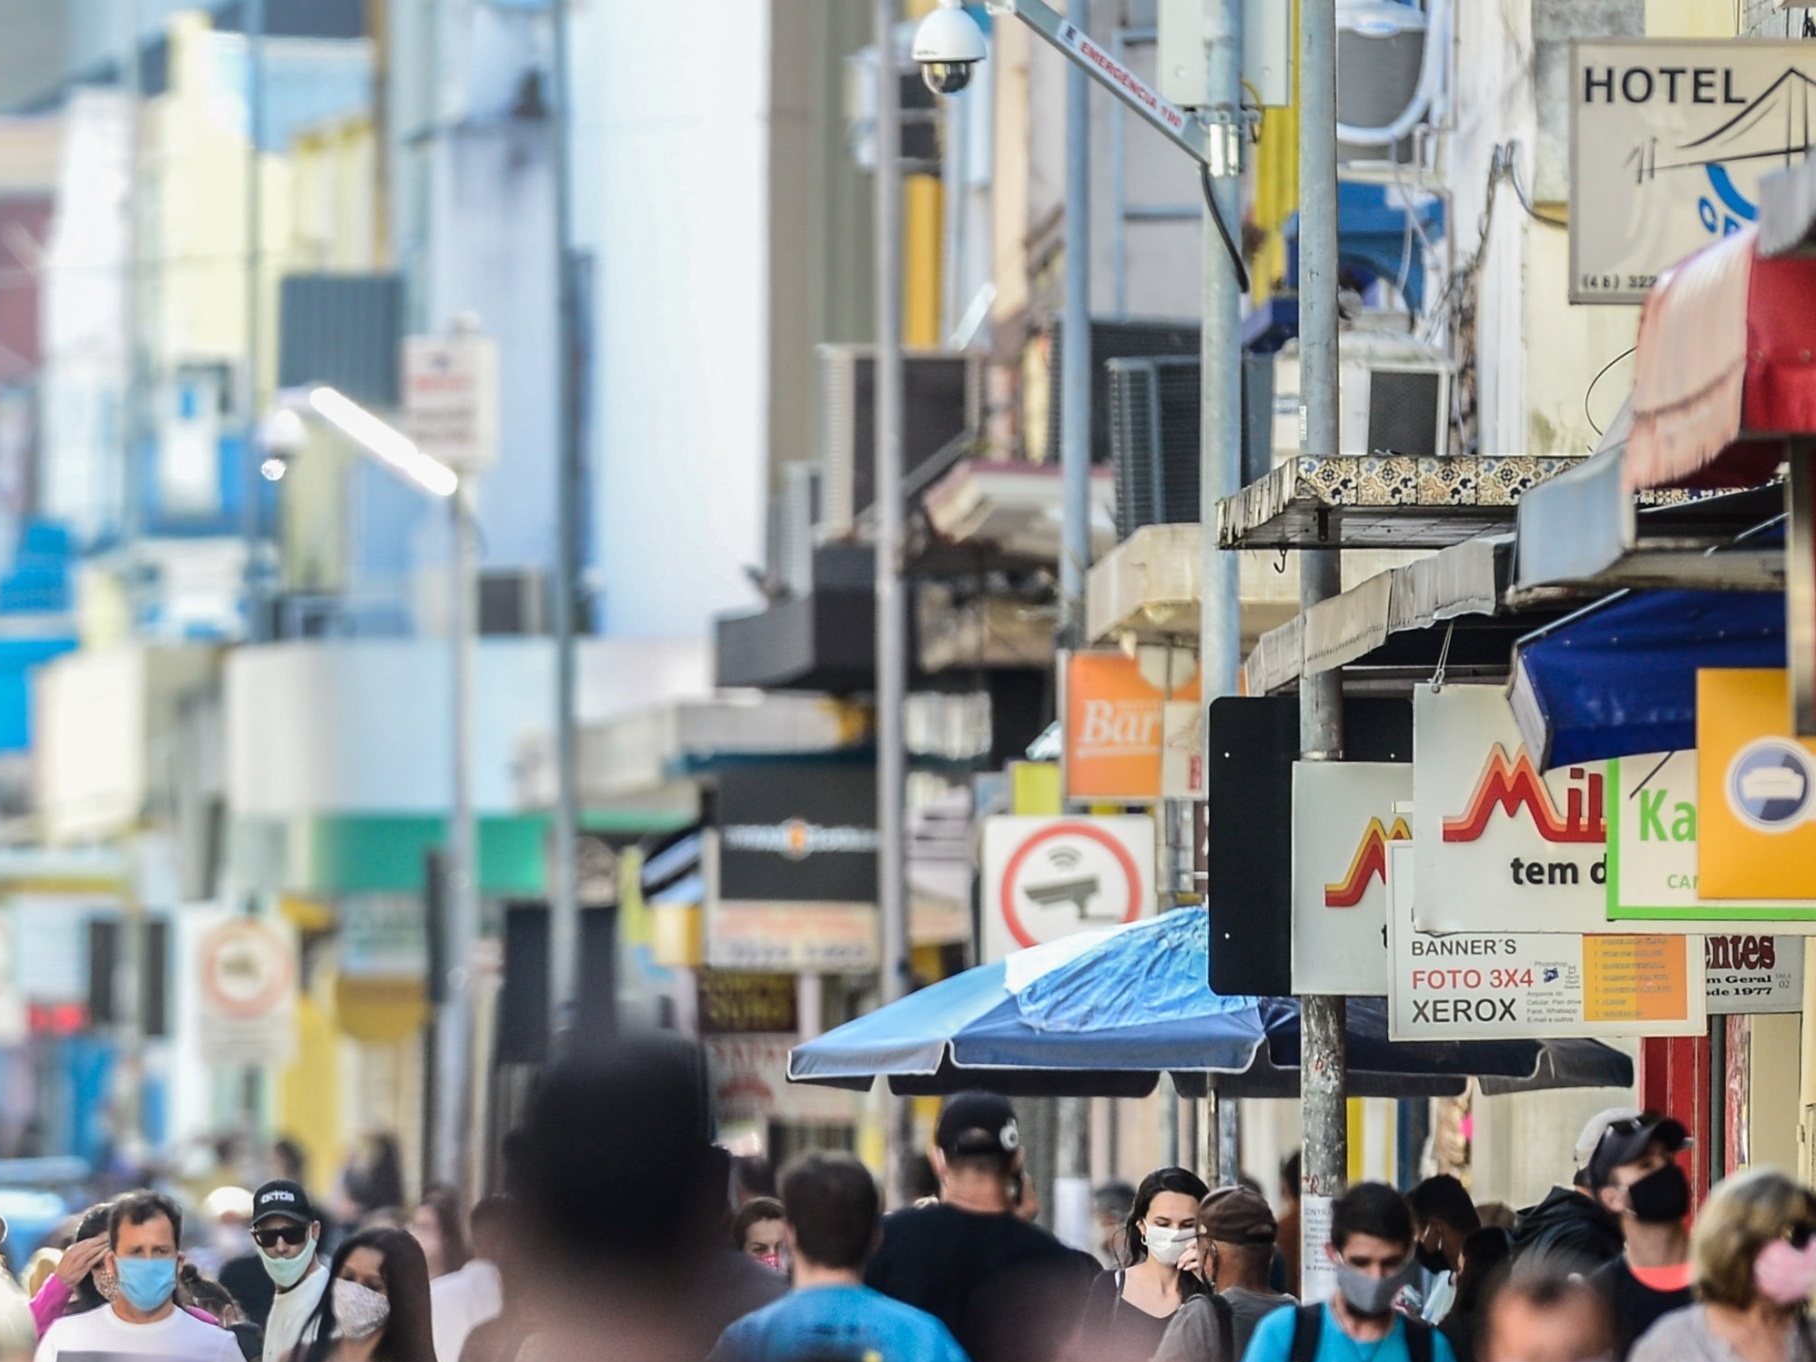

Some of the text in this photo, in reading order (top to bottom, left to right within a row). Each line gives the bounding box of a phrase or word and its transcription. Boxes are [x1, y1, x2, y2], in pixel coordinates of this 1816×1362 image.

[1585, 67, 1747, 104] HOTEL
[1081, 698, 1161, 745] Bar
[1510, 856, 1579, 884] tem
[1412, 967, 1535, 990] FOTO 3X4
[1725, 974, 1773, 985] Geral
[1733, 986, 1773, 997] 1977
[1412, 998, 1517, 1024] XEROX
